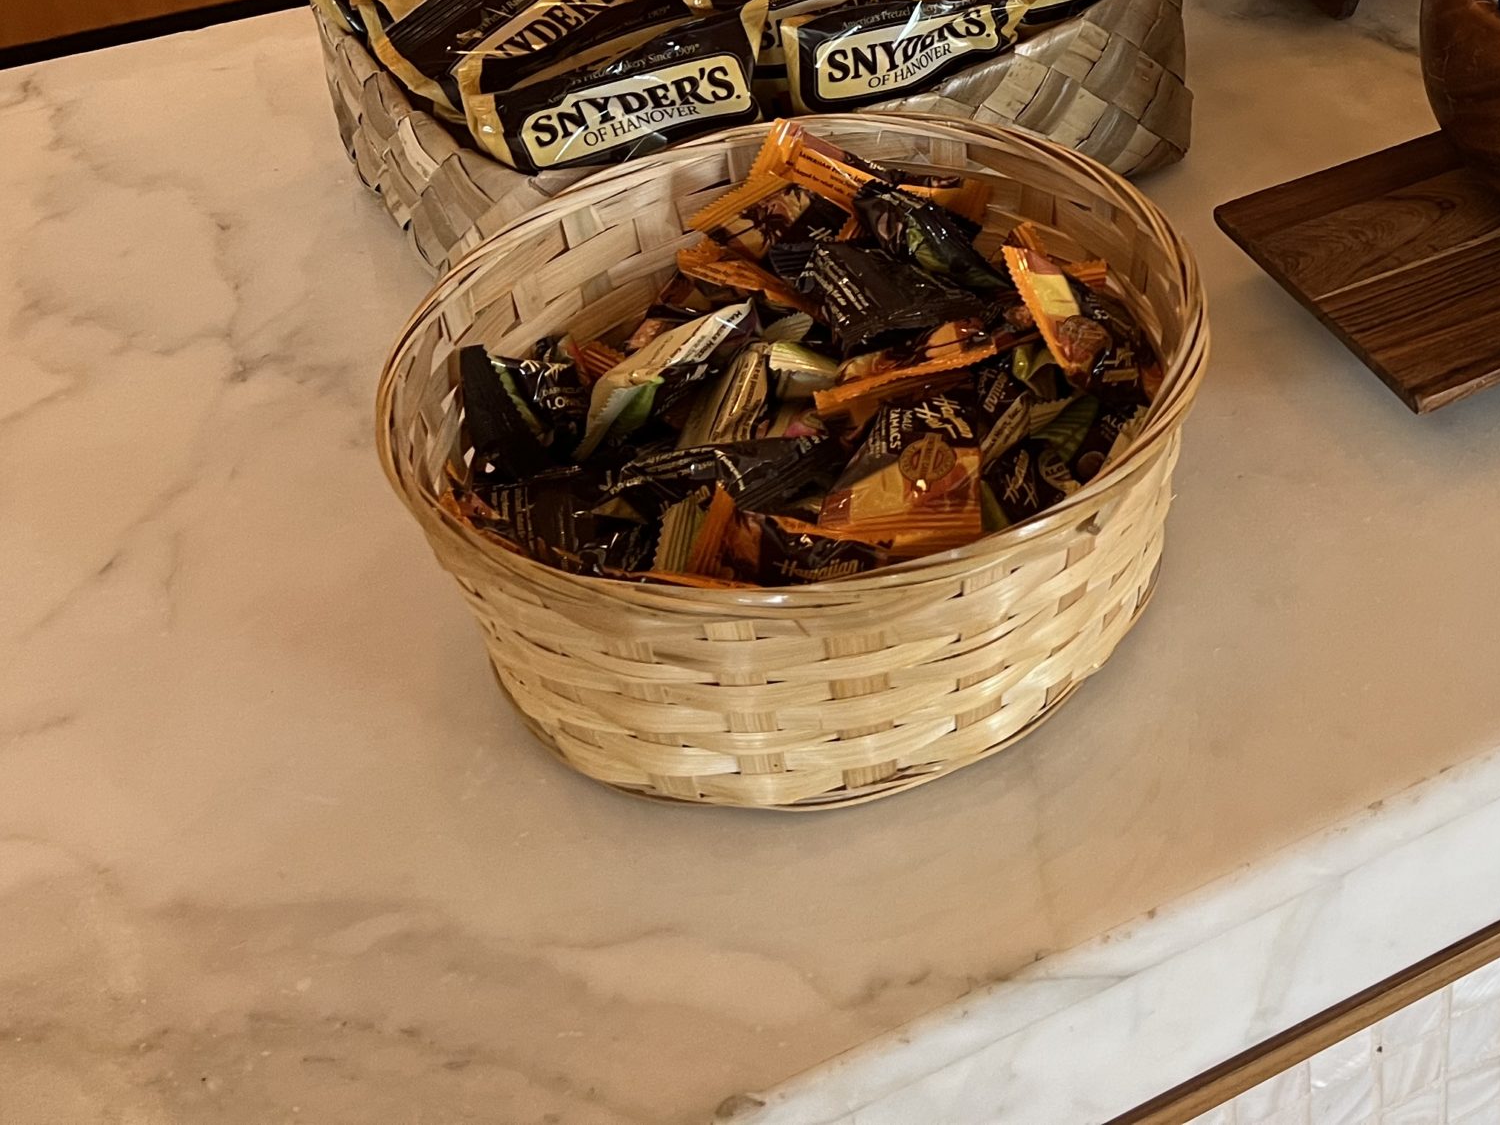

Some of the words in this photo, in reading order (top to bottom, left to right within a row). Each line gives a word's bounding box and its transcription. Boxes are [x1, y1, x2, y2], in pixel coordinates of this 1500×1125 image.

[881, 8, 910, 22] Pretzel
[648, 50, 672, 65] Since
[868, 75, 890, 89] OF
[894, 43, 952, 83] HANOVER
[531, 66, 734, 147] SNYDER'S
[583, 127, 607, 147] OF
[612, 105, 700, 138] HANOVER
